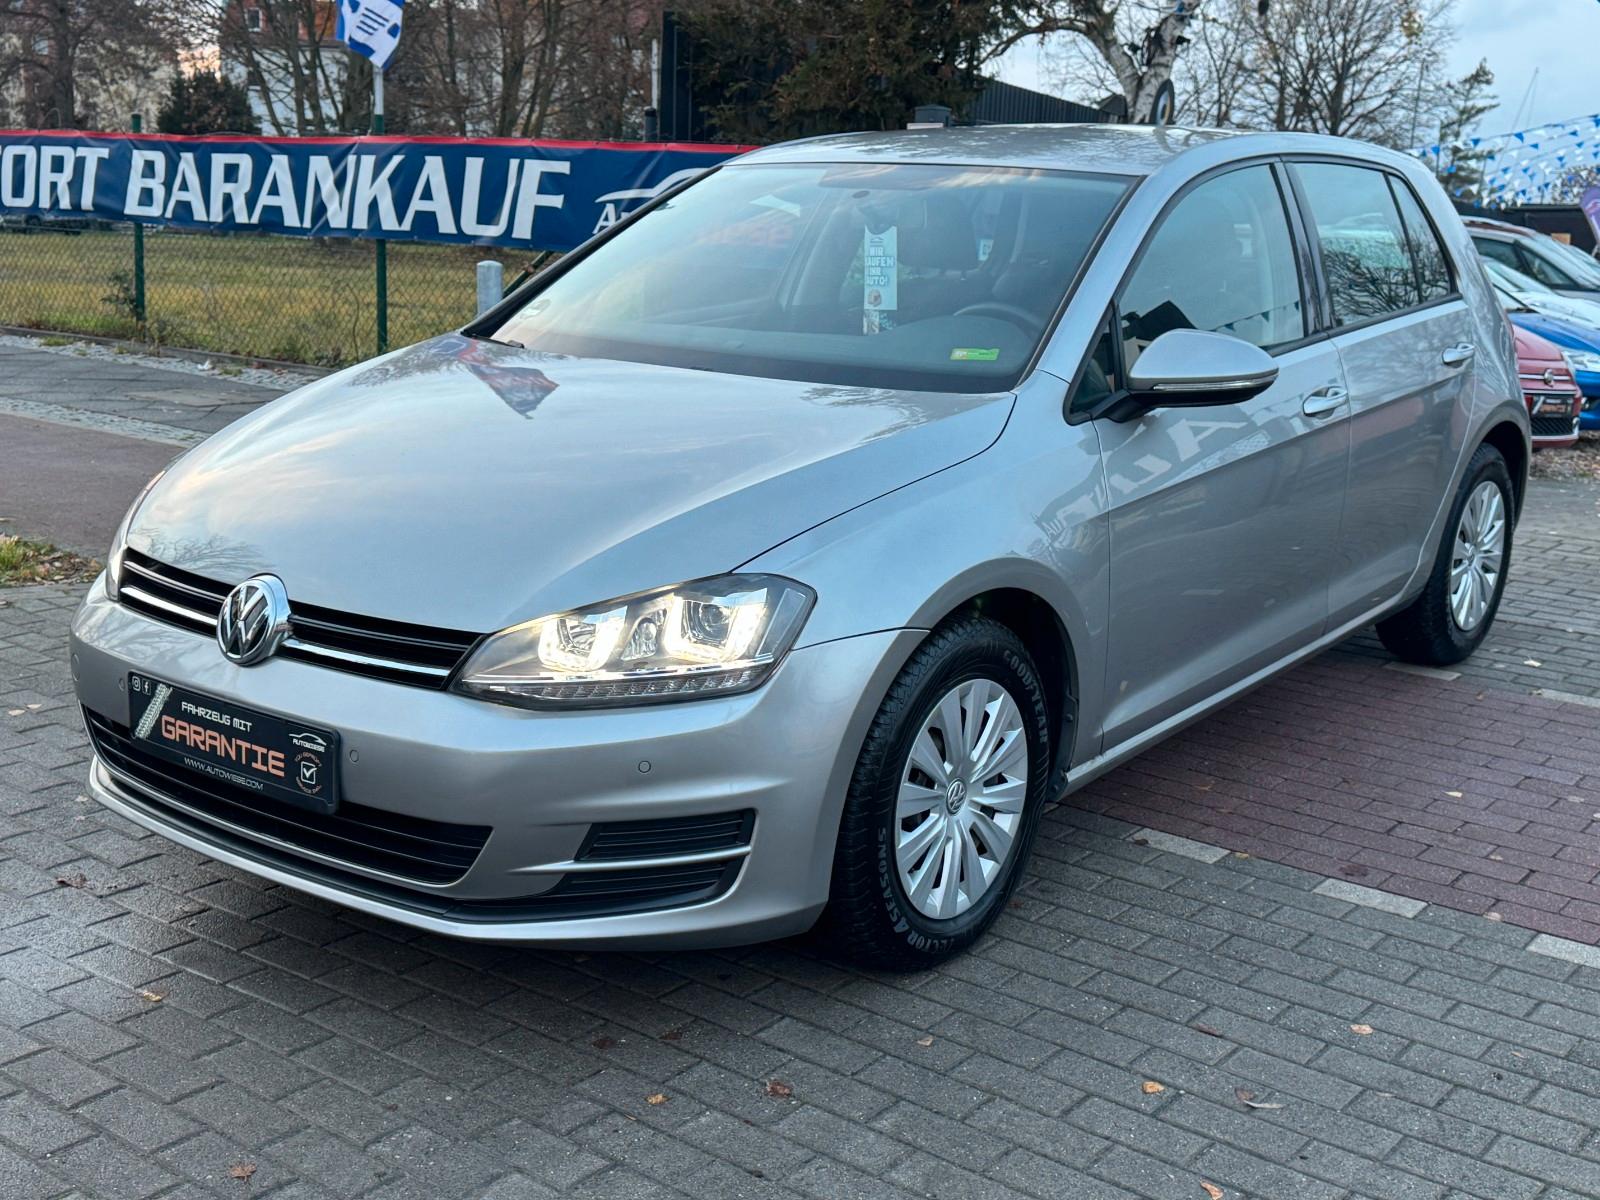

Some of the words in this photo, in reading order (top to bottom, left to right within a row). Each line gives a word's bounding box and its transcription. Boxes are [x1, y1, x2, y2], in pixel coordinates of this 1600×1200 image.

[0, 145, 110, 211] ORT
[124, 149, 571, 240] BARANKAUF
[181, 701, 231, 726] FAHRZEUG
[233, 718, 253, 733] MIT
[161, 714, 285, 778] GARANTIE
[184, 757, 264, 791] WWW.AUTOWIESE.COM
